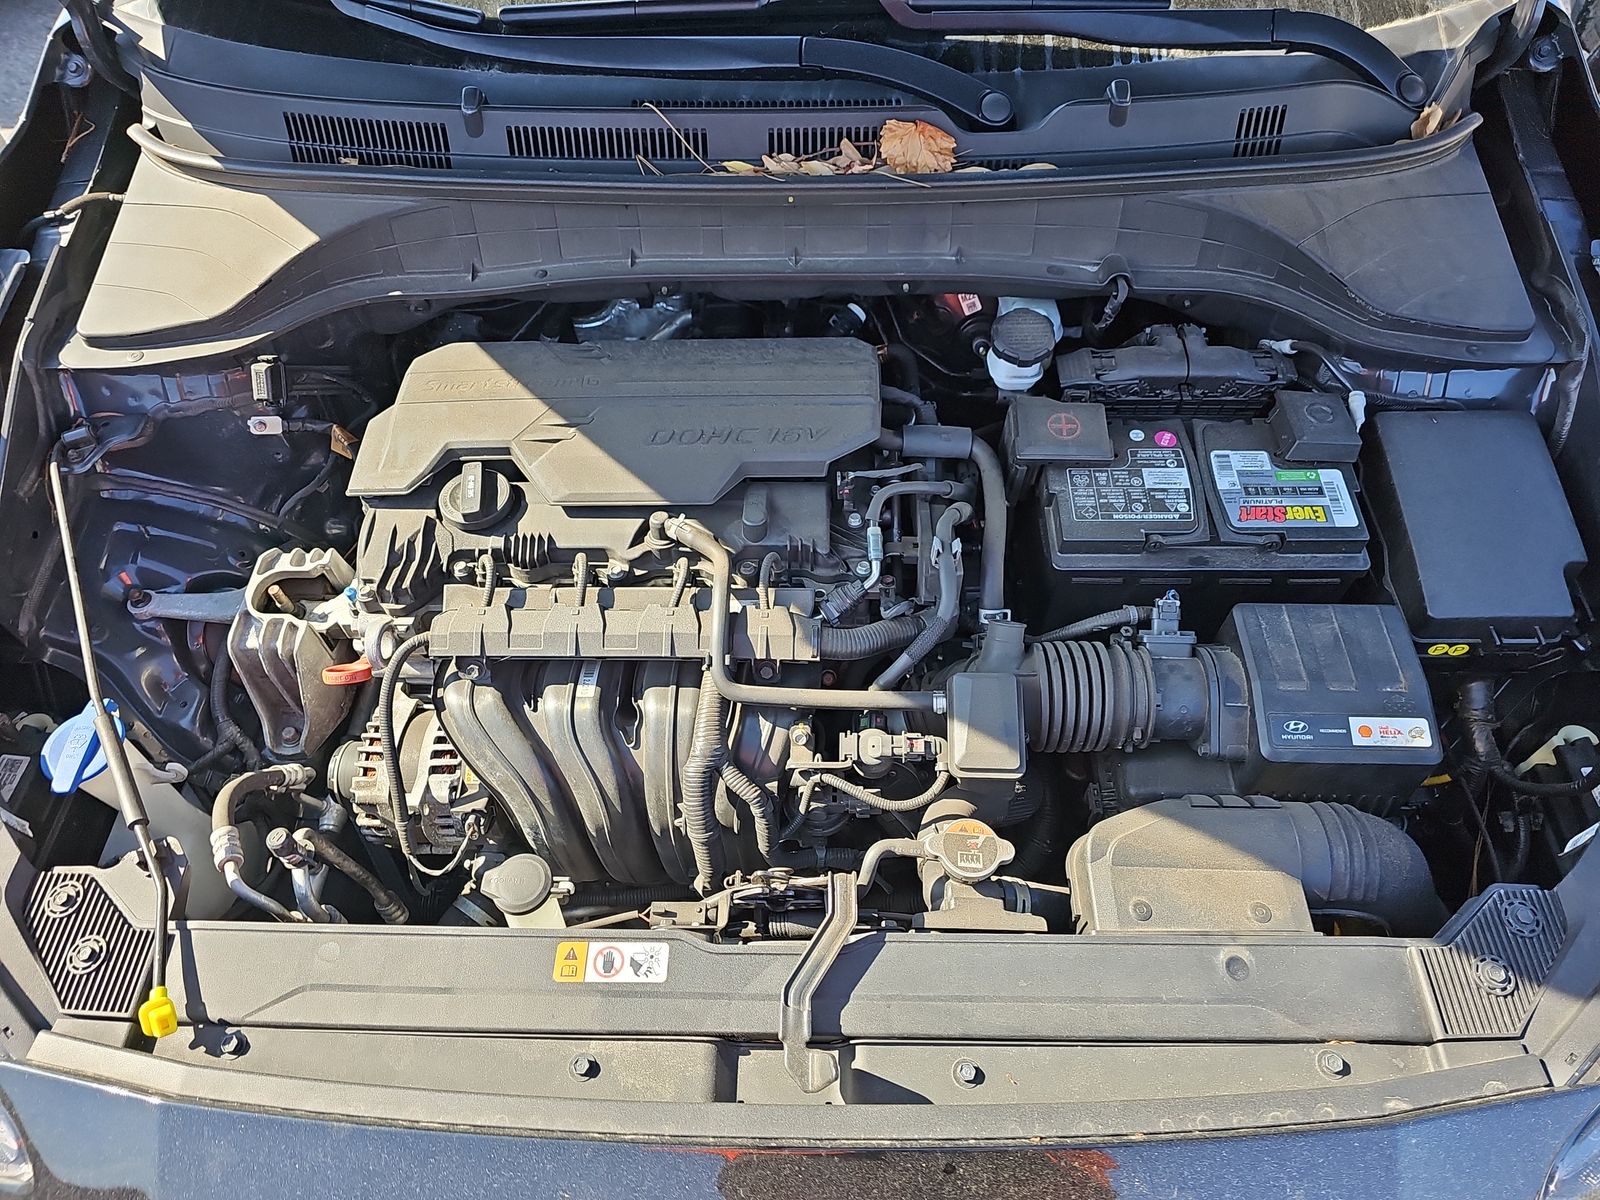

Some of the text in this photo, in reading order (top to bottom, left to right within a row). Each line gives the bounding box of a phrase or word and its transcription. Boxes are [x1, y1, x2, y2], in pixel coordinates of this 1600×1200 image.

[647, 426, 830, 447] DOHC 16V
[1239, 505, 1327, 523] EverStart
[1379, 728, 1404, 736] HELIX
